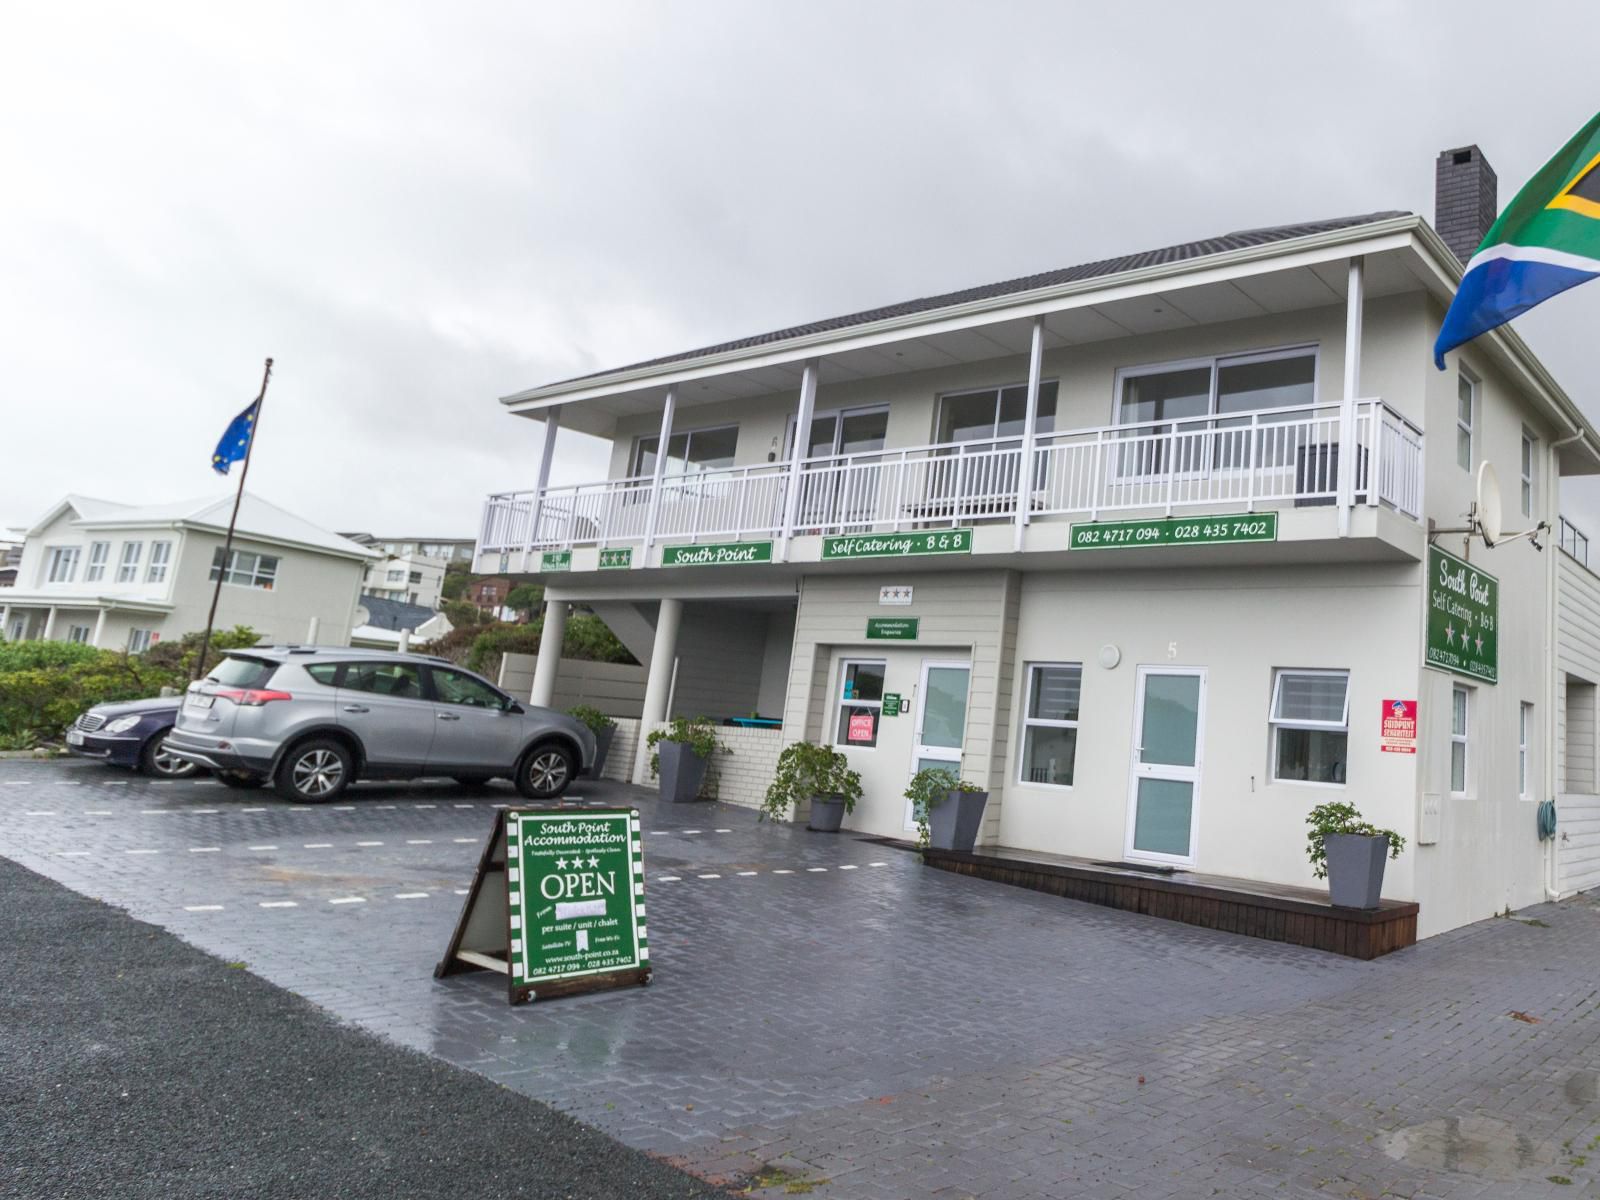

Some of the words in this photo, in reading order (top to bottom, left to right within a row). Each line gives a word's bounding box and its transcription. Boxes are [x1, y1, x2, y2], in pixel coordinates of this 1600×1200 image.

[1077, 530, 1099, 543] 082
[1103, 529, 1132, 542] 4717
[1135, 527, 1159, 540] 094
[1174, 525, 1199, 538] 028
[1203, 523, 1227, 536] 435
[1232, 522, 1266, 535] 7402
[855, 538, 913, 553] Catering
[926, 535, 936, 549] B
[938, 535, 949, 549] &
[953, 534, 962, 548] B
[674, 548, 714, 564] South
[716, 546, 757, 562] Point
[1439, 559, 1467, 595] South
[1469, 572, 1489, 606] Point
[1432, 589, 1446, 611] Self
[1446, 596, 1472, 628] Catering
[1167, 641, 1177, 659] 5
[851, 718, 872, 727] OFFICE
[852, 729, 869, 737] OPEN
[540, 821, 577, 835] South
[578, 822, 611, 834] Point
[524, 833, 627, 846] Accommodation
[541, 871, 615, 900] OPEN
[541, 925, 554, 935] per
[554, 922, 572, 931] suite
[573, 922, 577, 930] /
[578, 920, 593, 929] unit
[593, 920, 598, 928] /
[598, 918, 618, 927] chalet
[545, 949, 619, 964] www.south-point.co.za
[548, 964, 566, 974] 4717
[567, 963, 580, 971] 094
[587, 960, 600, 969] 028
